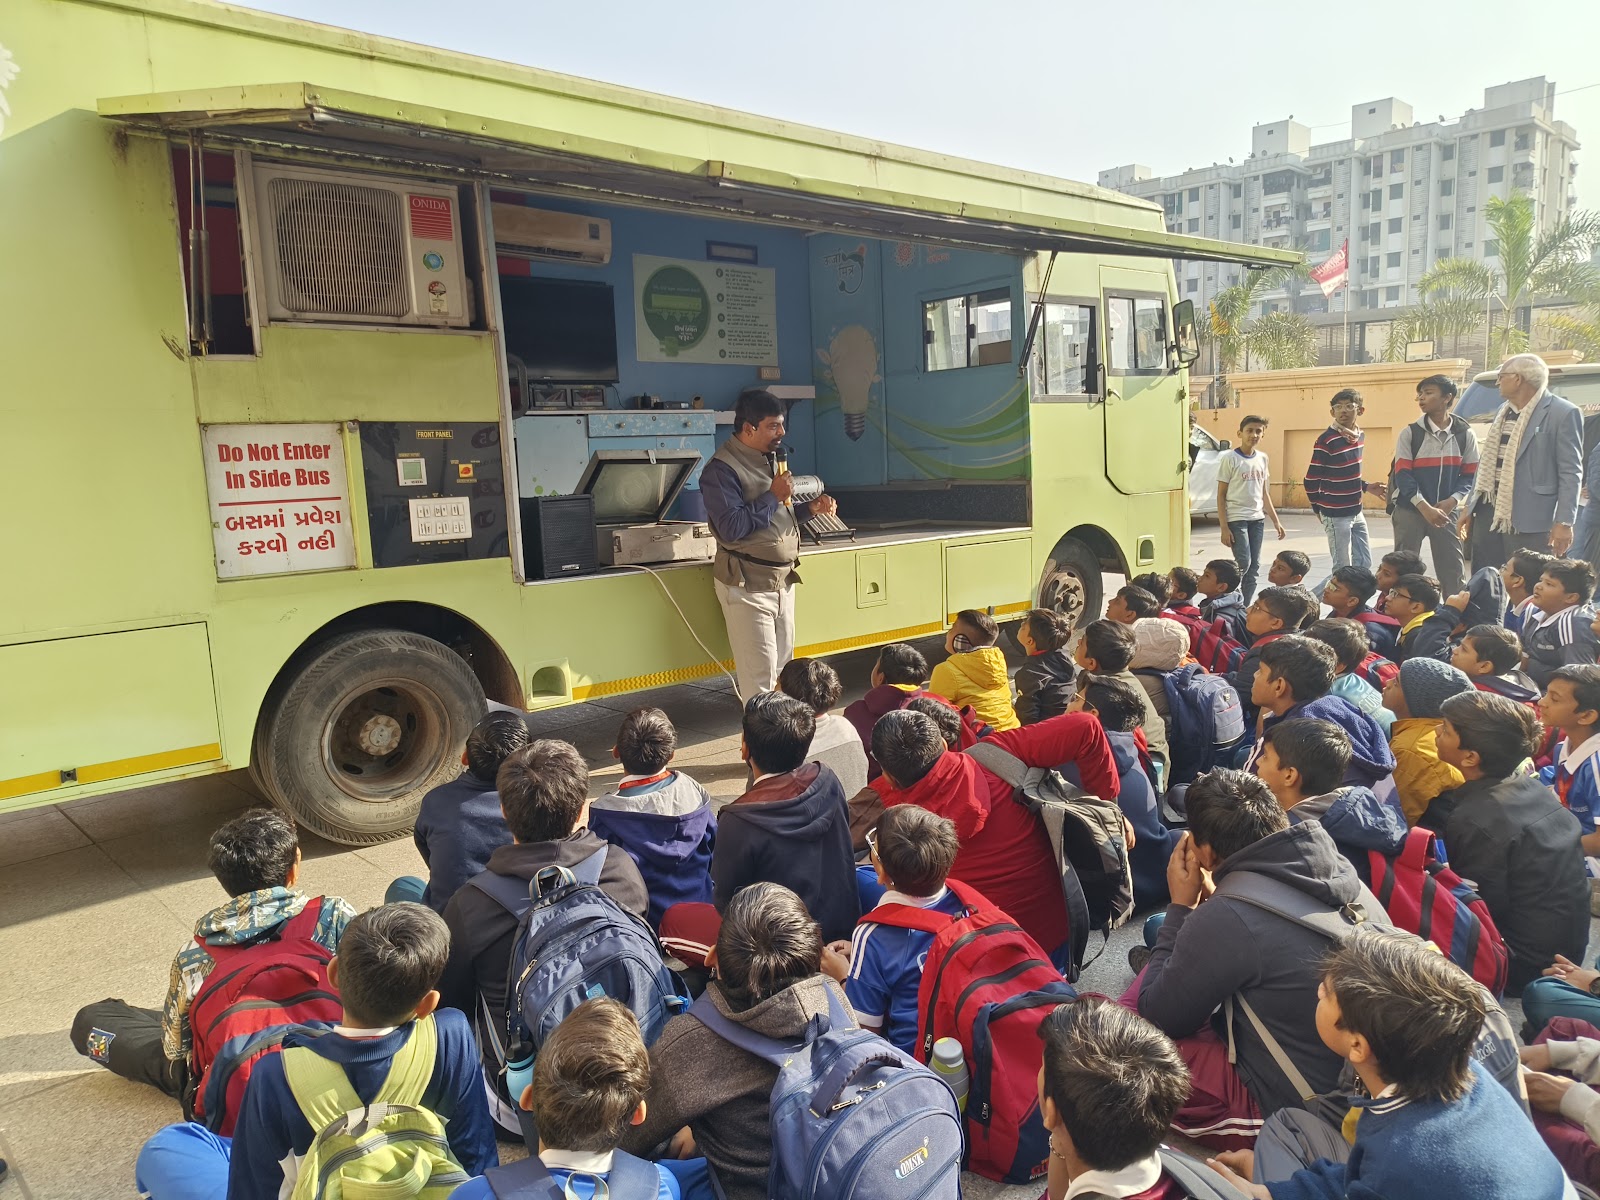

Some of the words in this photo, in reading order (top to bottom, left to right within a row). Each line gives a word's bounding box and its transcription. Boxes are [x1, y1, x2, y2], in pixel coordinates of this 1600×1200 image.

[412, 198, 448, 211] ONIDA
[217, 444, 244, 462] Do
[247, 443, 280, 461] Not
[282, 442, 331, 460] Enter
[225, 471, 245, 489] In
[248, 469, 291, 488] Side
[295, 468, 331, 486] Bus
[225, 508, 285, 531] બસમાં
[293, 505, 342, 526] પ્રવેશ
[237, 532, 288, 556] કરવો
[297, 529, 336, 550] નહી
[900, 1151, 925, 1175] OMSK
